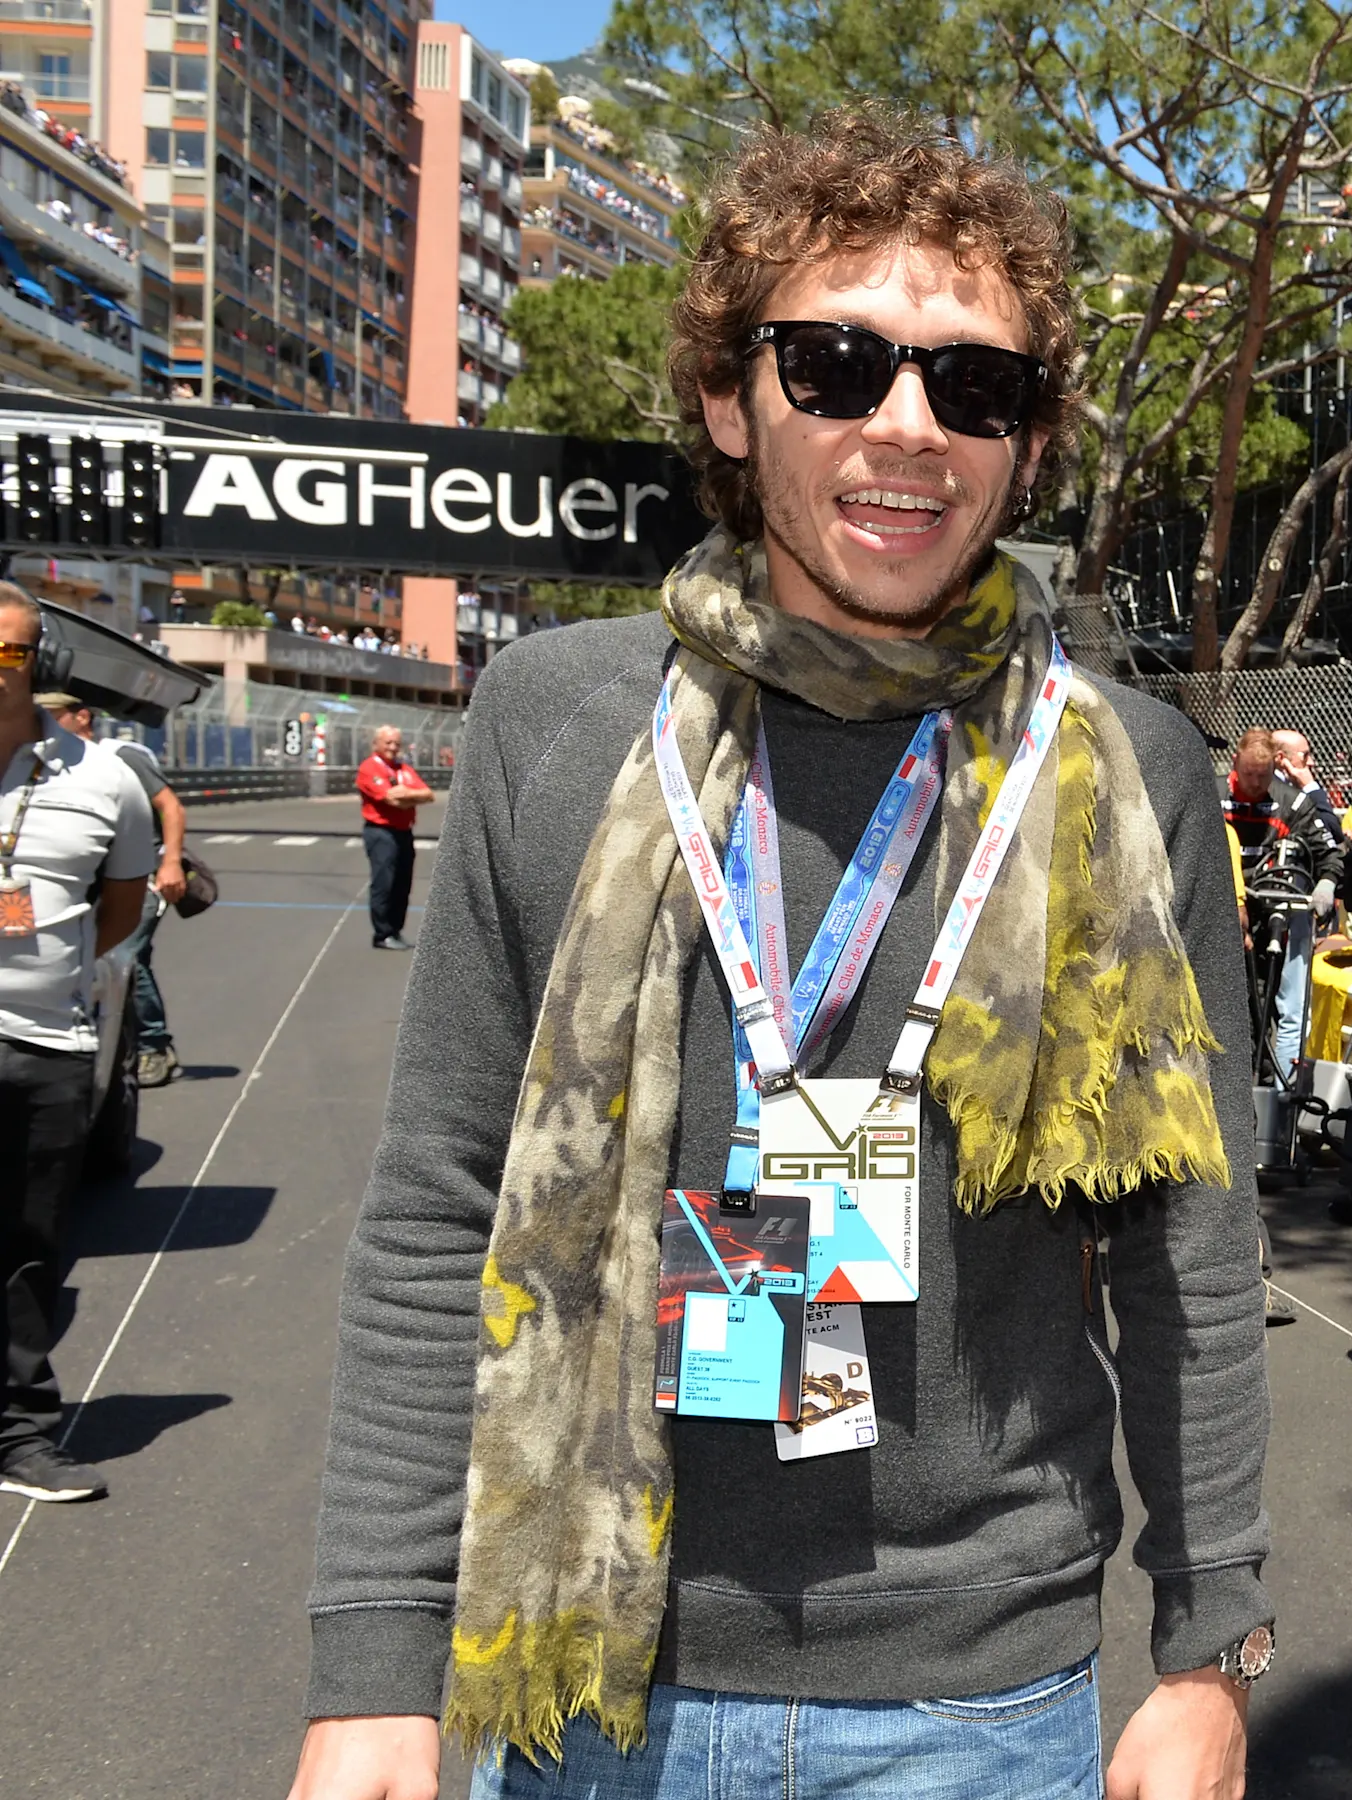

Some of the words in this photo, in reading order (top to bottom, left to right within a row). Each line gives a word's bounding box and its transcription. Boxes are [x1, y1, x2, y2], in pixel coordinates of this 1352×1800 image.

[160, 449, 669, 544] AGHeuer
[285, 719, 301, 756] 100
[904, 776, 937, 840] Automobile
[755, 806, 769, 855] Monaco
[687, 831, 720, 894] GRID
[860, 832, 884, 869] 2013
[972, 824, 1005, 880] GRID
[856, 900, 885, 946] Monaco
[765, 922, 783, 992] Automobile
[850, 944, 864, 962] de
[838, 962, 857, 991] Club
[762, 1152, 916, 1180] GRID
[904, 1186, 912, 1204] FOR
[903, 1206, 911, 1237] MONTE
[903, 1239, 911, 1269] CARLO
[808, 1310, 832, 1322] EST
[820, 1324, 840, 1335] ACM
[847, 1362, 863, 1379] D
